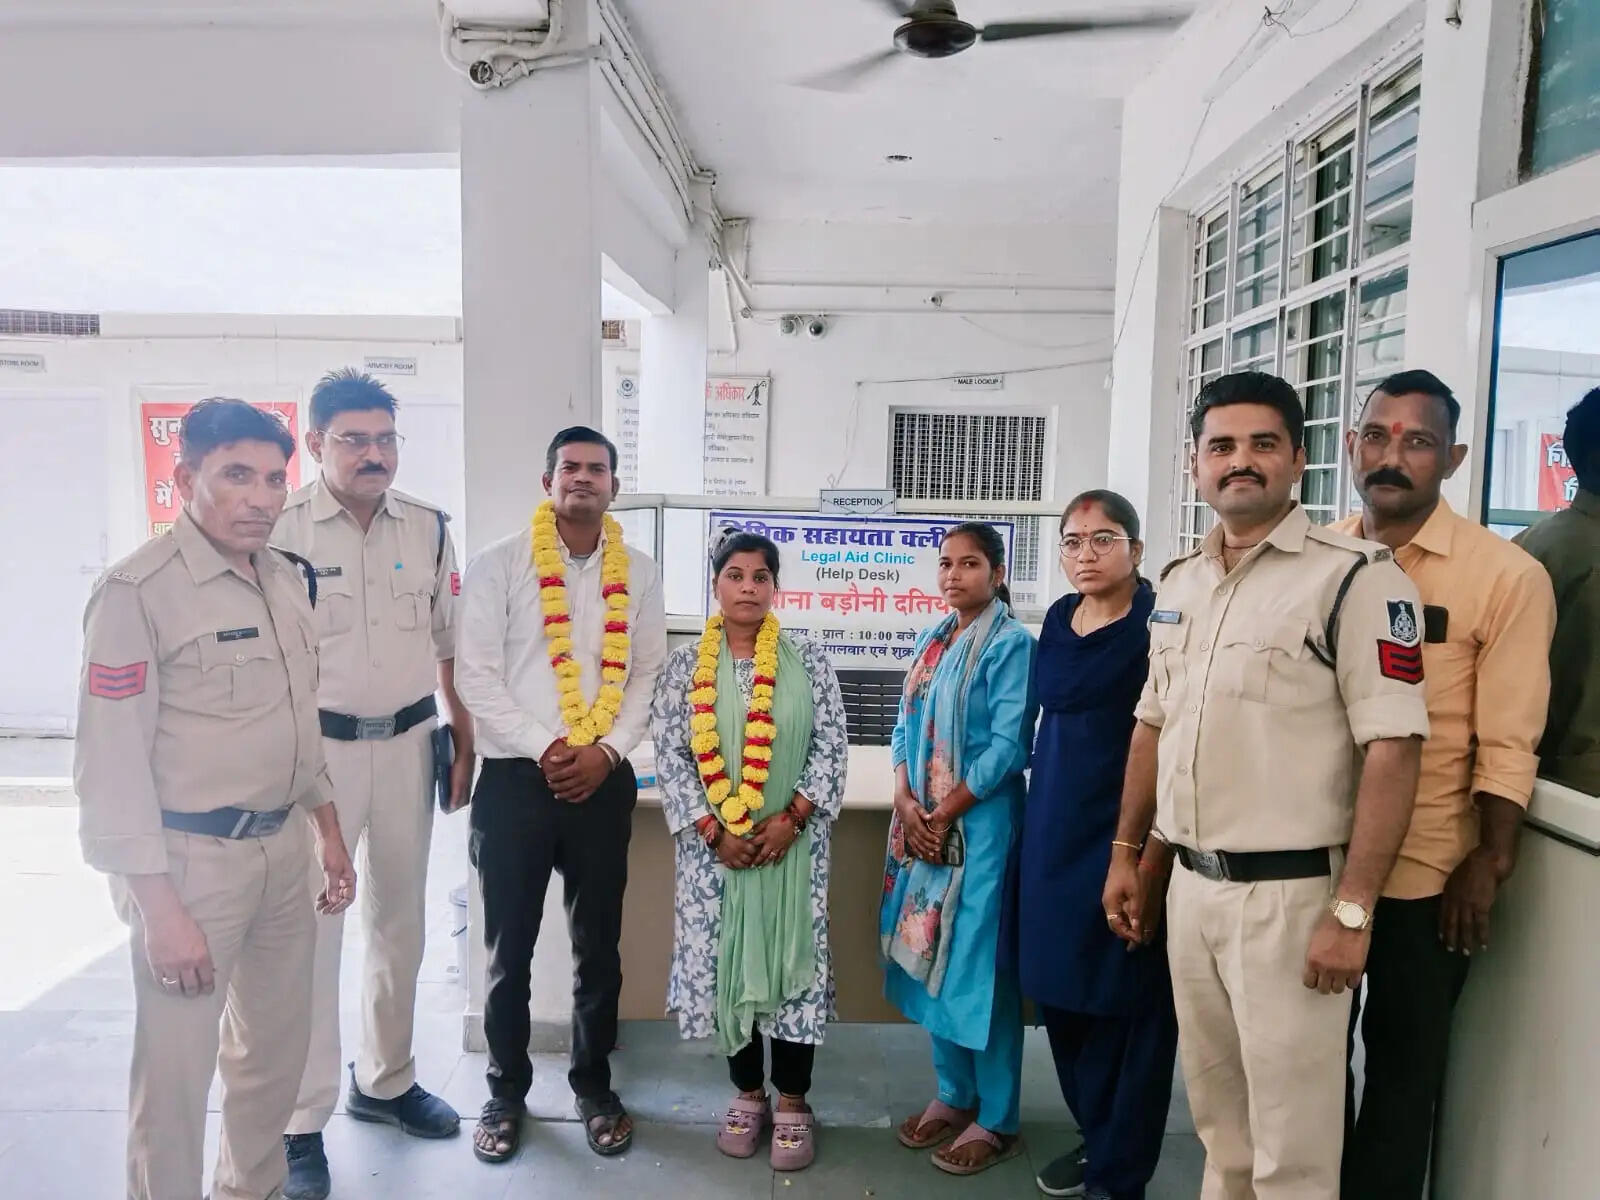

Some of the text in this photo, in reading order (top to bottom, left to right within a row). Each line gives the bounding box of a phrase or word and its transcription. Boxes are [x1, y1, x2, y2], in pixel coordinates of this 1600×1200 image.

[833, 497, 883, 507] RECEPTION
[802, 527, 896, 547] सहायता
[801, 550, 915, 565] Legal Aid Clinic
[816, 567, 900, 584] (Help Desk)
[818, 581, 888, 616] बड़ौनी
[893, 587, 949, 616] दतिय
[859, 630, 892, 641] 10:00
[869, 643, 888, 658] एवं
